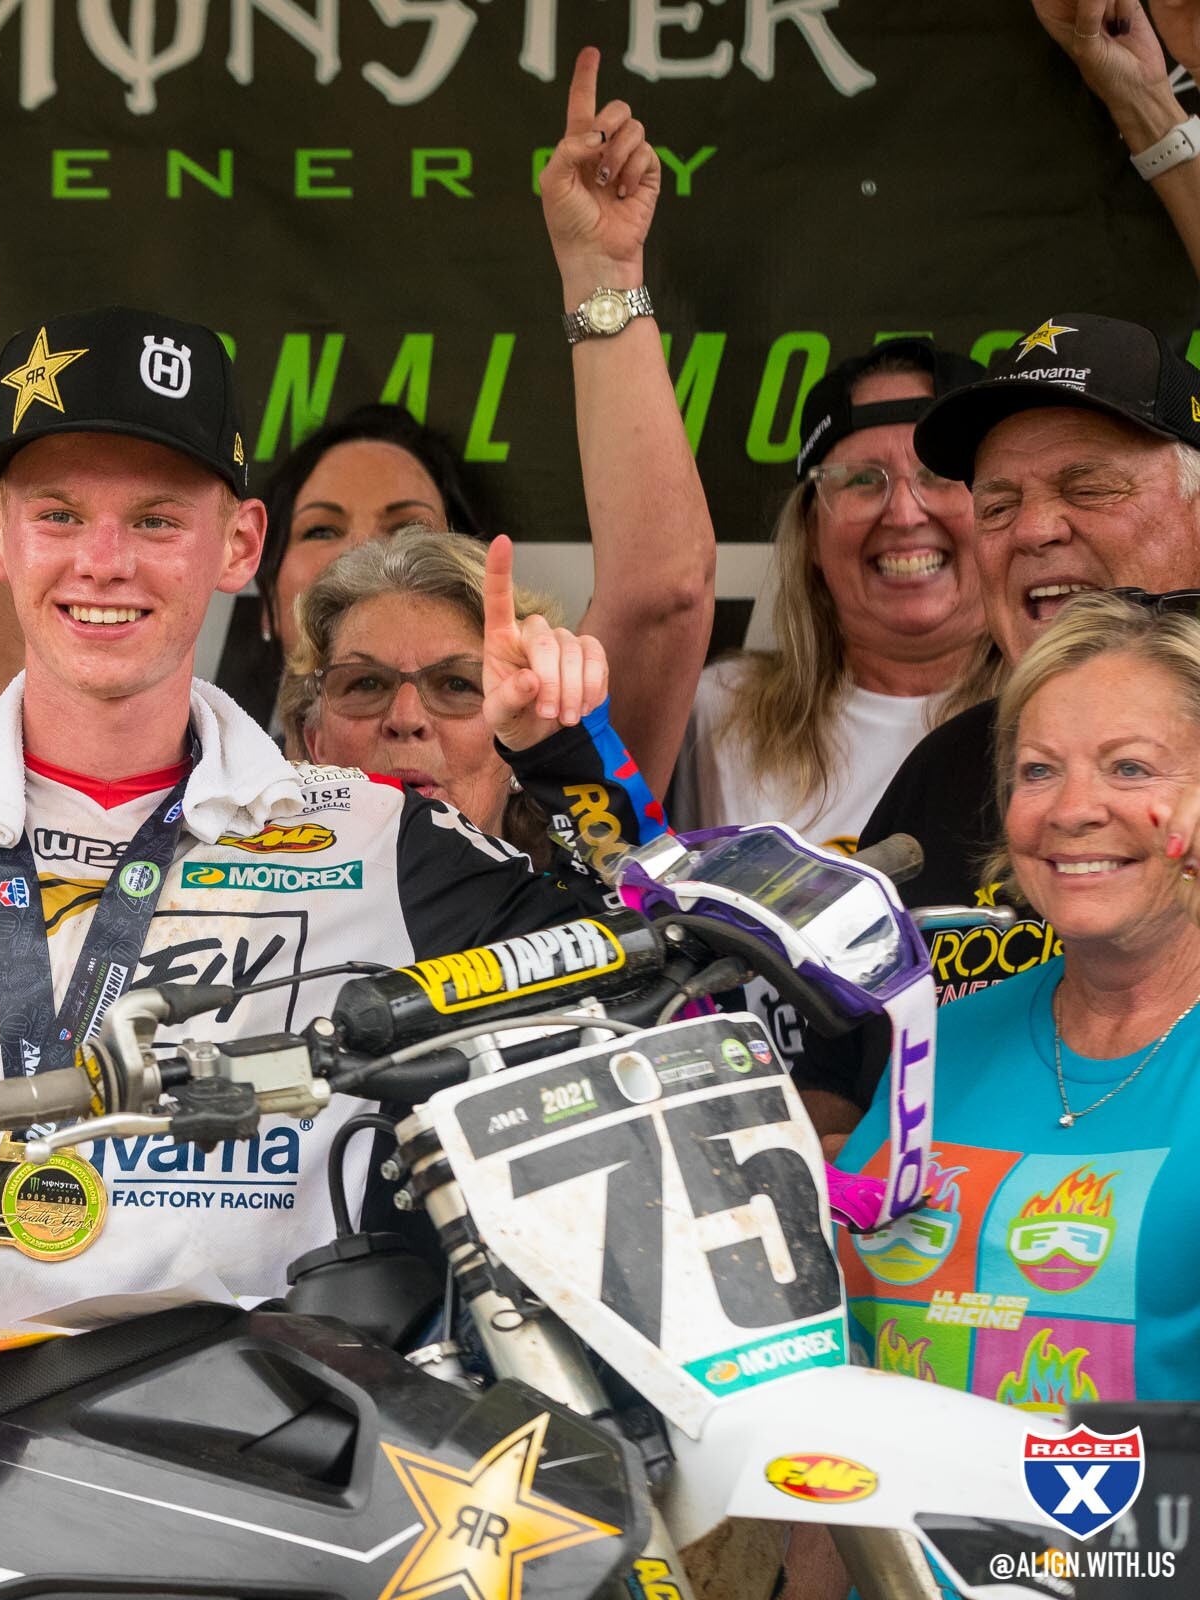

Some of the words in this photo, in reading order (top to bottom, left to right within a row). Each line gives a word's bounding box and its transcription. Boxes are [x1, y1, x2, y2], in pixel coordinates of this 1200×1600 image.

[53, 147, 717, 199] ENERY
[302, 802, 351, 814] CADILLAC
[228, 864, 356, 890] MOTOREX
[540, 1078, 595, 1114] 2021
[41, 1179, 80, 1191] MONSTER
[19, 1192, 46, 1202] 1982
[57, 1196, 84, 1205] 2021
[112, 1190, 216, 1208] FACTORY
[220, 1192, 295, 1210] RACING
[508, 1085, 843, 1348] 75
[21, 1231, 77, 1250] CHAMPIONSHIP
[925, 1304, 1025, 1331] RACING
[736, 1329, 840, 1376] MOTOREX
[766, 1456, 879, 1493] FMF
